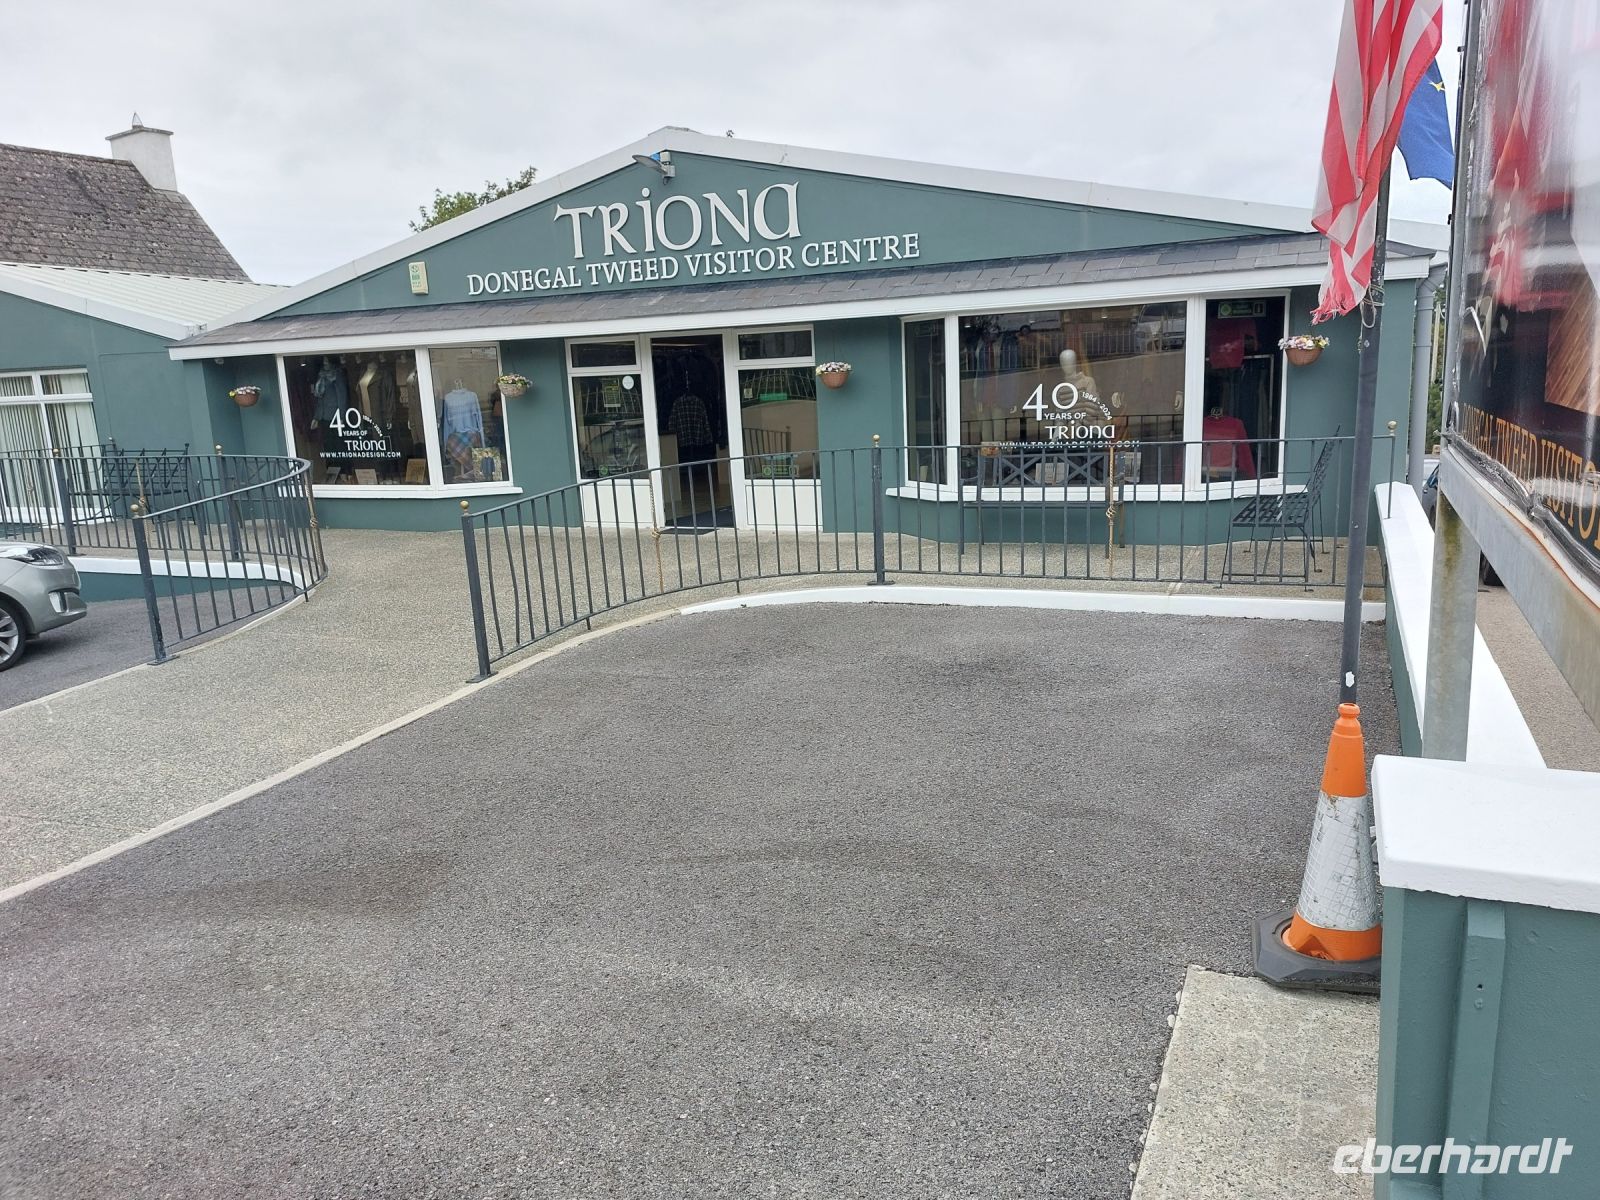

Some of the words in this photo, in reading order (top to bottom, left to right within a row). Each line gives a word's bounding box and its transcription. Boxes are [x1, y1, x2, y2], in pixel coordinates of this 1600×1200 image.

[467, 265, 583, 296] DONEGAL
[585, 256, 679, 285] TWEED
[684, 244, 795, 277] VISITOR
[802, 232, 921, 267] CENTRE
[1022, 382, 1079, 421] 40
[1044, 412, 1072, 420] YEARS
[1074, 412, 1087, 420] OF
[1099, 403, 1113, 421] 2024
[329, 407, 362, 437] 40
[1541, 438, 1600, 551] VISITO
